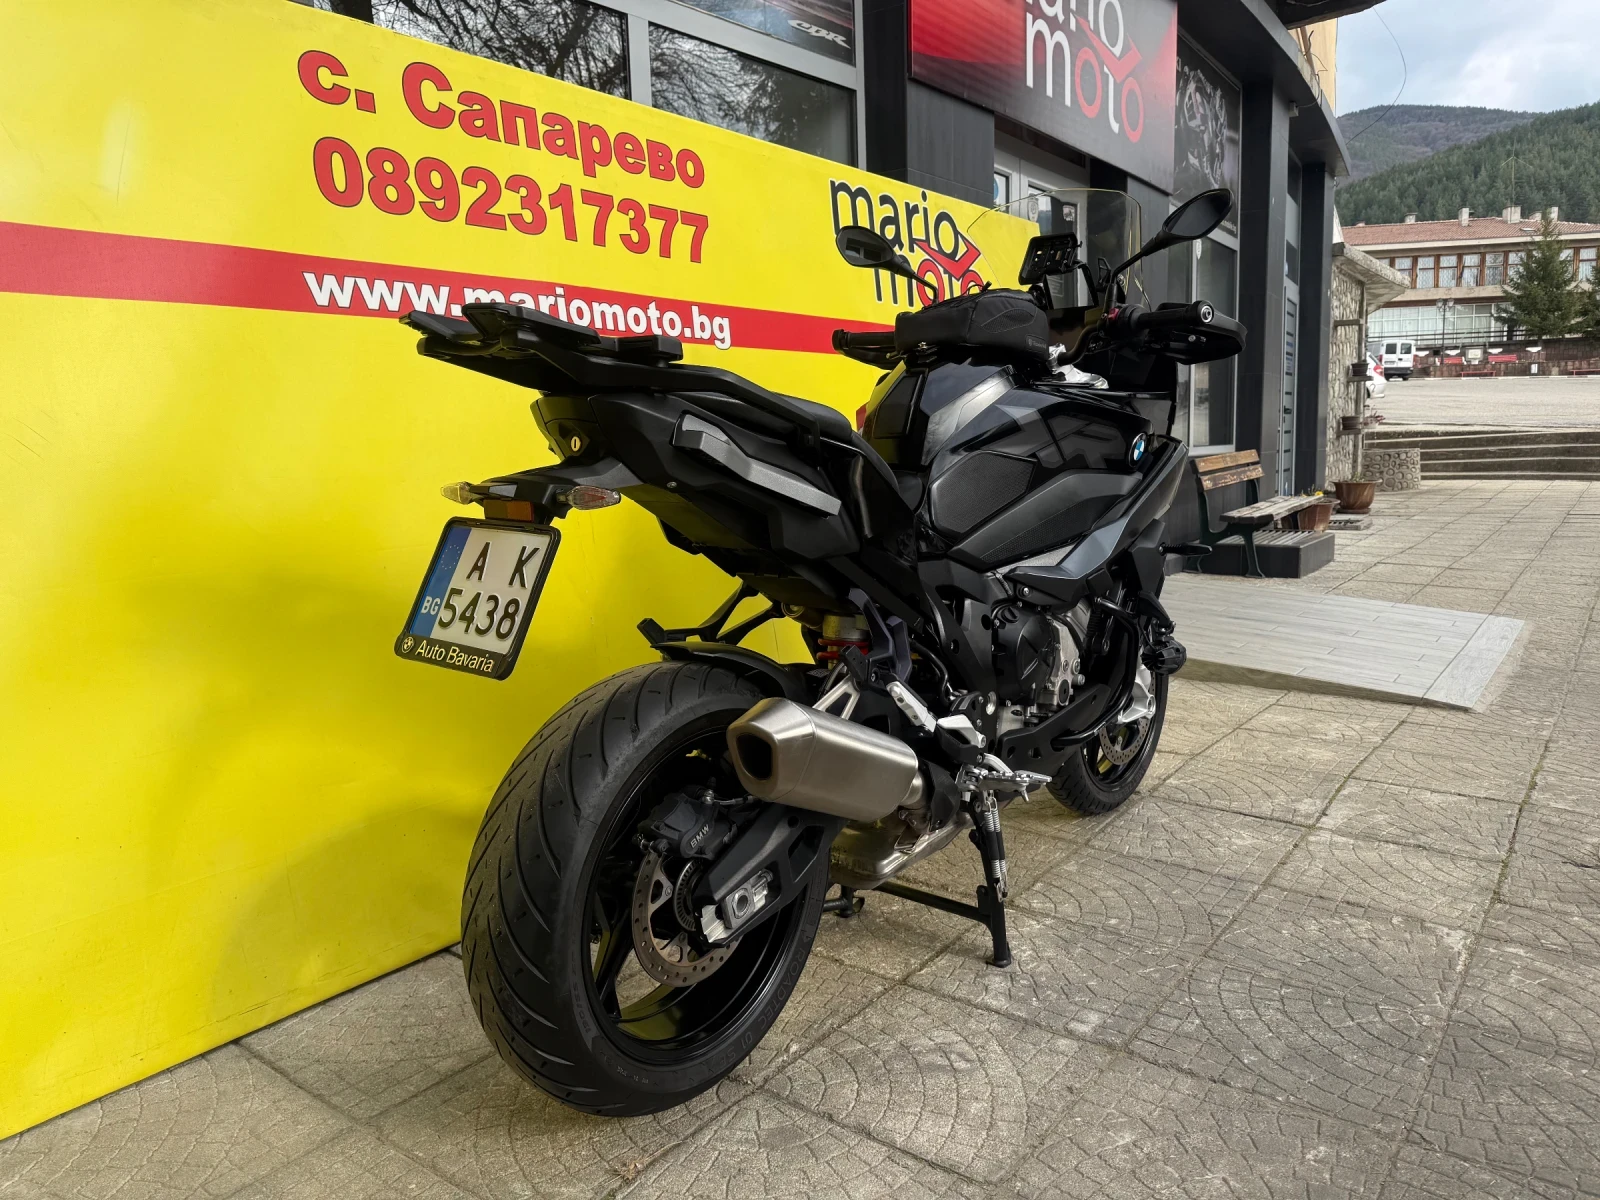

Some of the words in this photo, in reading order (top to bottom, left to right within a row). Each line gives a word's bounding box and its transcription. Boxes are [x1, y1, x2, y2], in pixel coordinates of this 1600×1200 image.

[1026, 12, 1144, 143] moto
[297, 49, 377, 114] с.
[401, 61, 705, 189] Сапарево
[313, 136, 709, 264] 0892317377
[829, 178, 960, 261] mario
[465, 541, 491, 582] A
[508, 545, 541, 589] K
[421, 596, 440, 616] BG
[438, 588, 521, 641] 5438
[415, 639, 445, 661] Auto
[446, 646, 496, 673] Bavaria
[690, 823, 709, 848] BMW
